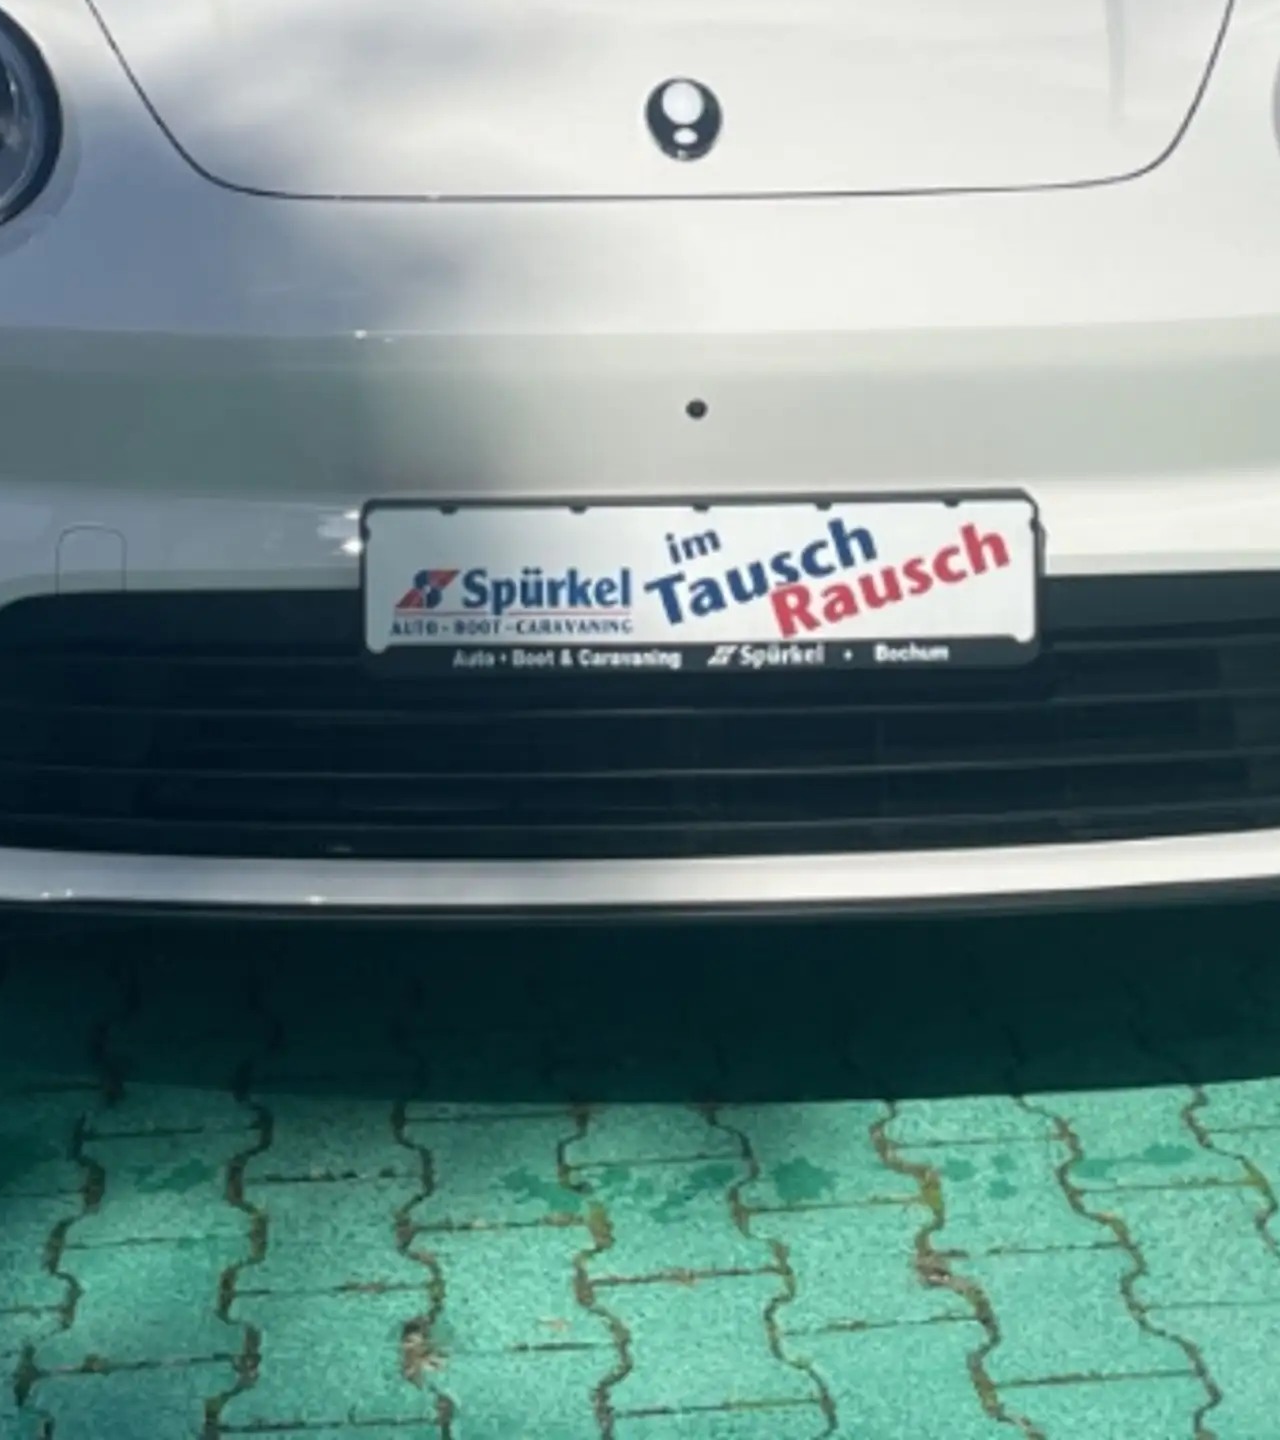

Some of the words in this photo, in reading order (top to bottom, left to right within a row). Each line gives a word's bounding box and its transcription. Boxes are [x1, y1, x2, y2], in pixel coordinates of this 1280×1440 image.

[664, 528, 722, 565] im
[461, 566, 632, 617] Spürkel
[644, 517, 878, 627] Tausch
[770, 522, 1011, 640] Rausch
[391, 618, 439, 637] AUTO
[454, 618, 502, 636] BOOT
[515, 617, 634, 636] CARAVANING
[452, 648, 497, 669] Auto
[740, 643, 826, 669] Spürkel
[873, 642, 950, 663] Bochum
